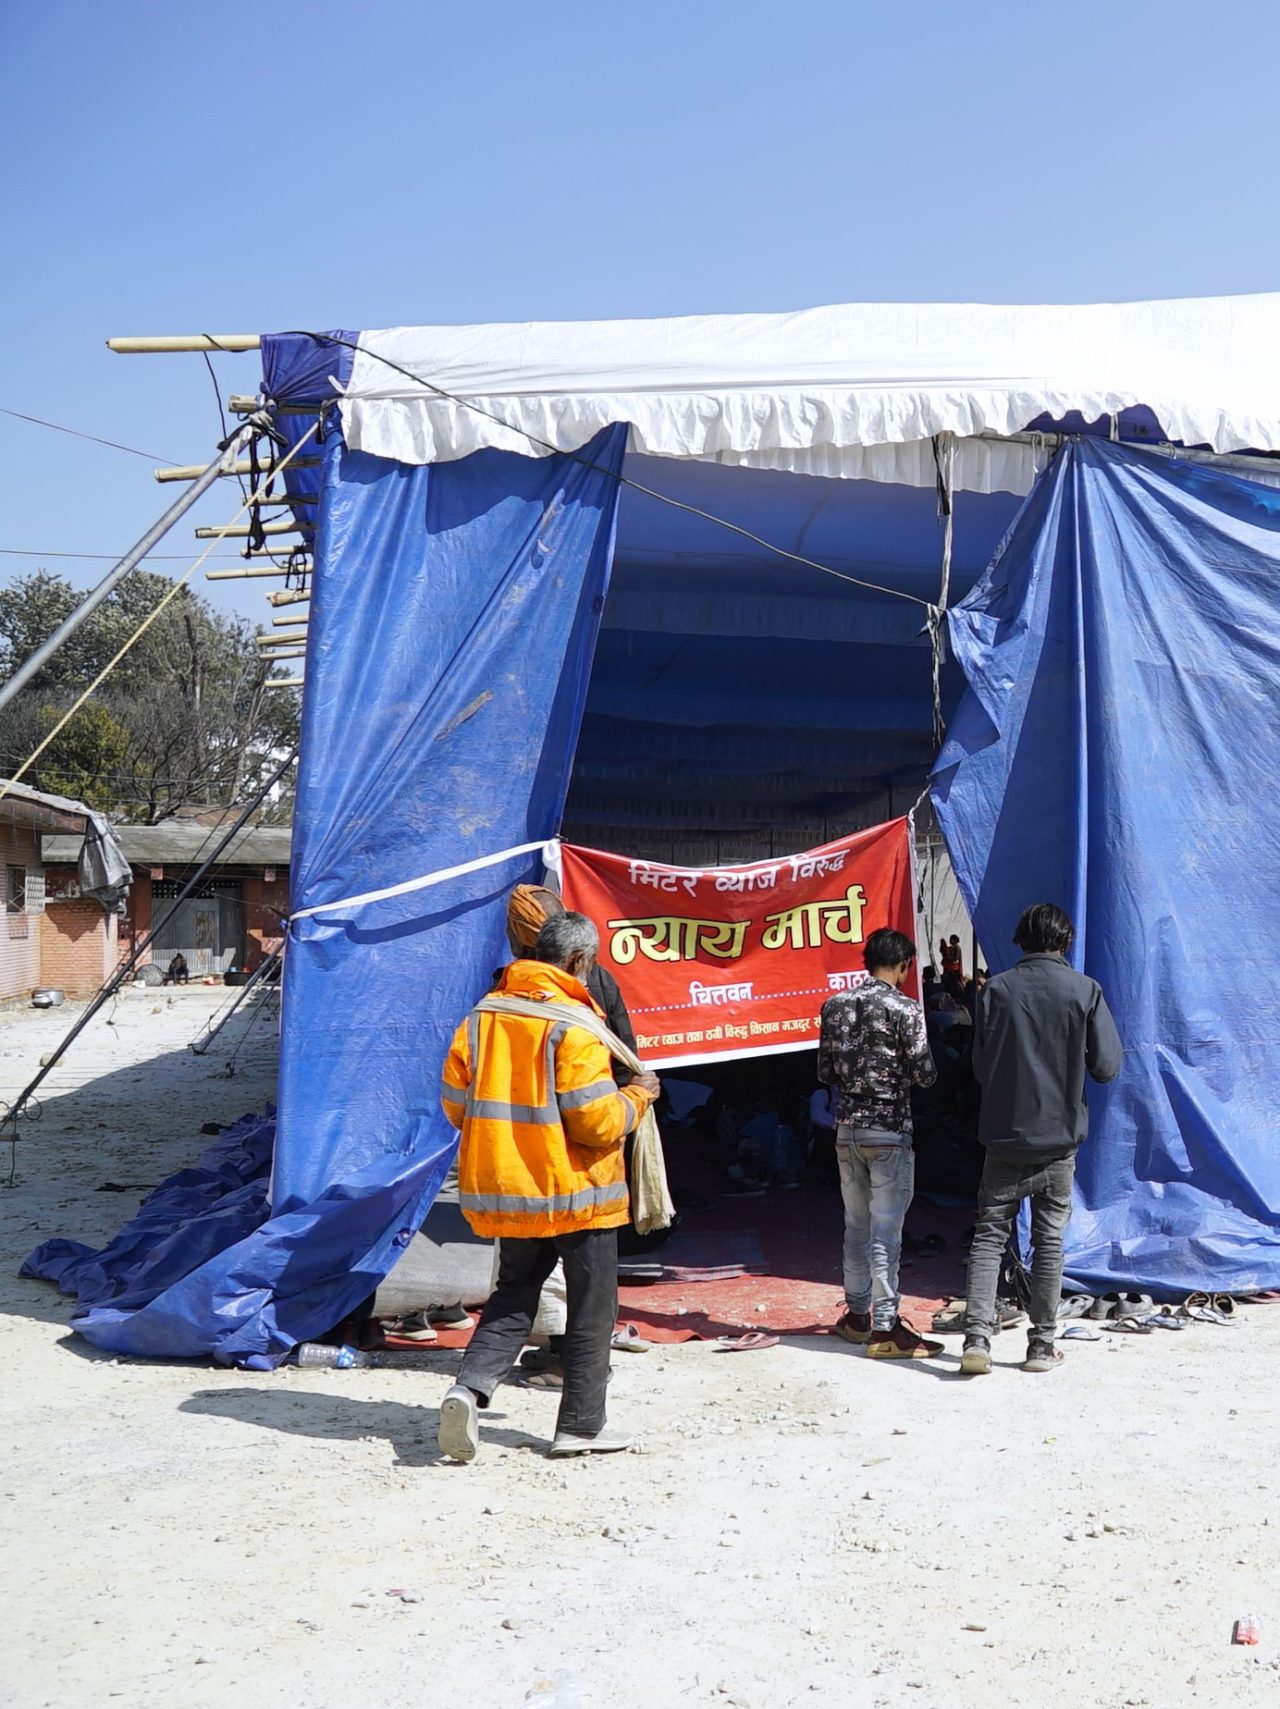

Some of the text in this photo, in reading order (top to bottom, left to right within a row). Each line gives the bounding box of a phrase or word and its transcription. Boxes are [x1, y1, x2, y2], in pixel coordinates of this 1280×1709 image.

[628, 861, 703, 897] मिटर
[714, 866, 781, 892] व्याज
[607, 884, 867, 965] न्याय मार्च
[689, 970, 870, 1006] चित्तवन काठ
[636, 1034, 659, 1049] मिटर
[749, 1020, 780, 1036] किसान
